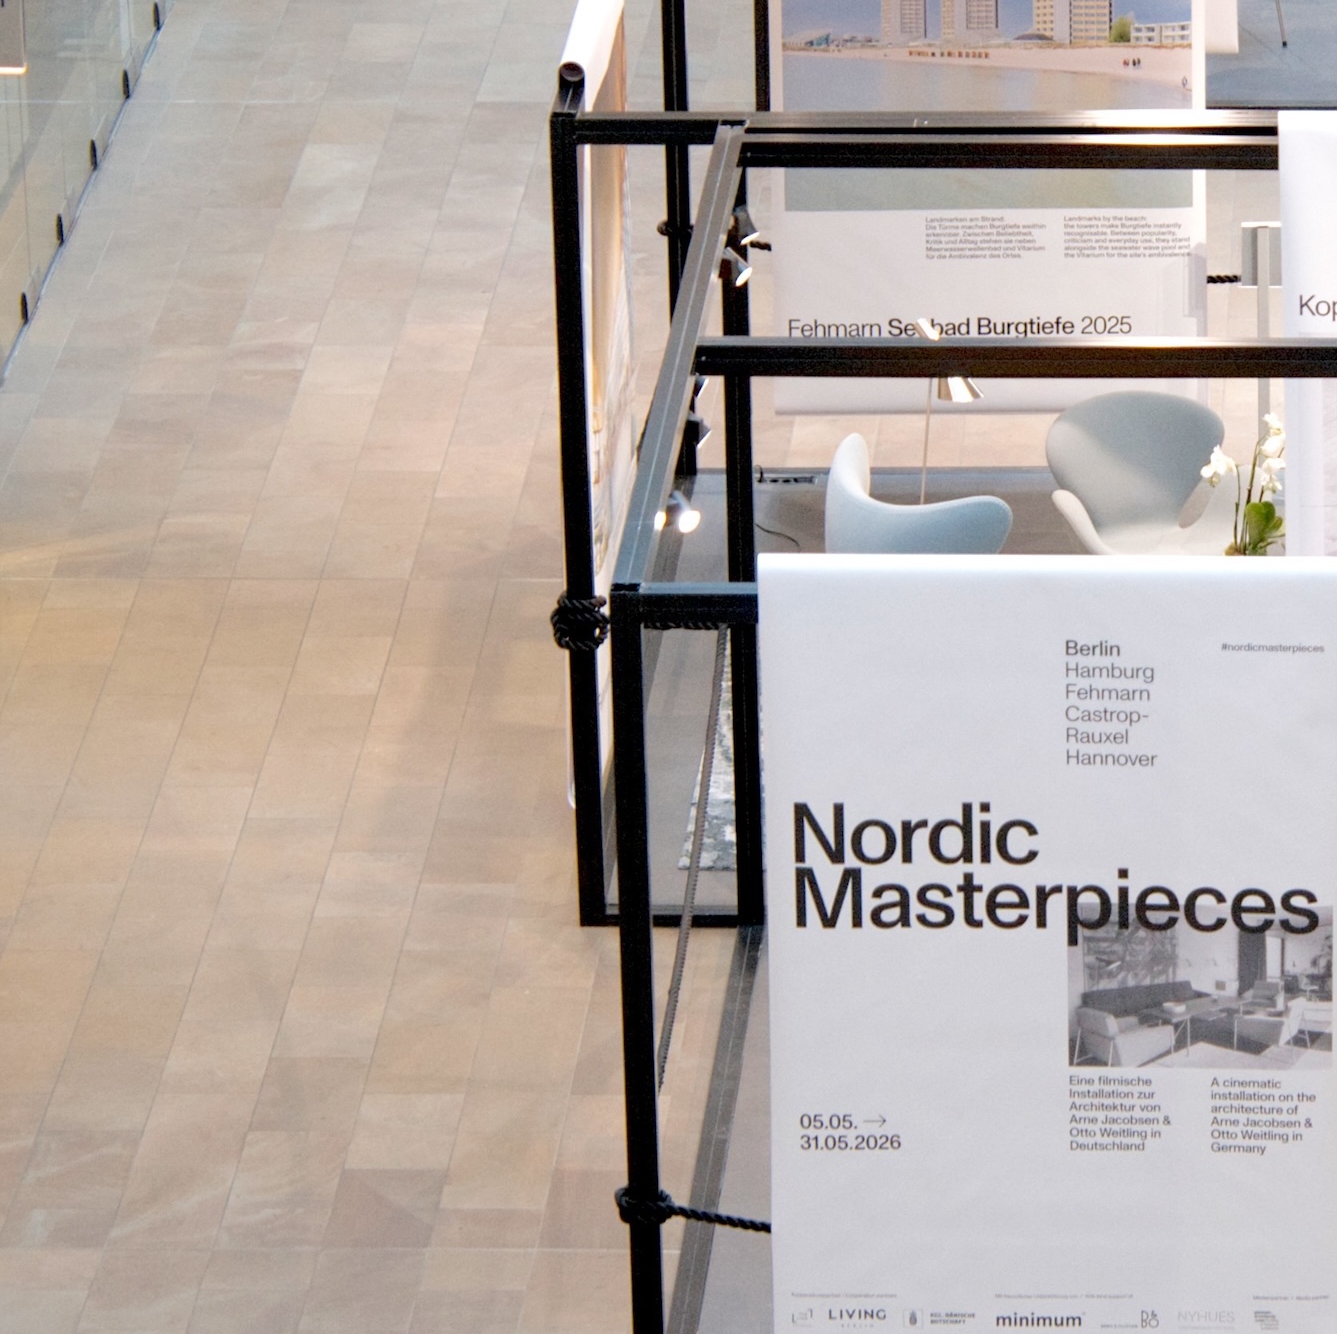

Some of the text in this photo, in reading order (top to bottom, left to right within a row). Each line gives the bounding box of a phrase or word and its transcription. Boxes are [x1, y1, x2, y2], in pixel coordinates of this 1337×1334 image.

[789, 316, 1132, 338] Fehmarn Sebad Burgtiefe 2025
[1065, 640, 1121, 656] Berlin
[1221, 643, 1324, 654] #nordicmasterpieces
[1065, 662, 1155, 683] Hamburg
[1065, 684, 1150, 701] Fehmarn
[1065, 706, 1149, 726] Castrop-
[1066, 727, 1129, 744] Rauxel
[1066, 749, 1157, 766] Hannover
[794, 802, 1040, 866] Nordic
[795, 867, 1320, 946] Masterpieces
[1069, 1076, 1152, 1086] Eine filmische
[1211, 1078, 1281, 1088] A cinematic
[1069, 1089, 1156, 1099] Installation zur
[1211, 1092, 1316, 1102] installation on the
[1069, 1102, 1161, 1112] Architektur von
[1211, 1104, 1298, 1115] architecture of
[800, 1113, 857, 1130] 05.05.
[1069, 1115, 1171, 1125] Arne Jacobsen &
[1211, 1117, 1313, 1128] Arne Jacobsen &
[1069, 1128, 1161, 1141] Otto Weitling in
[1211, 1130, 1303, 1143] Otto Weitling in
[800, 1134, 901, 1151] 31.05.2026
[1070, 1141, 1145, 1151] Deutschland
[1211, 1143, 1266, 1155] Germany
[829, 1309, 887, 1320] LIVING
[996, 1312, 1082, 1327] minimum
